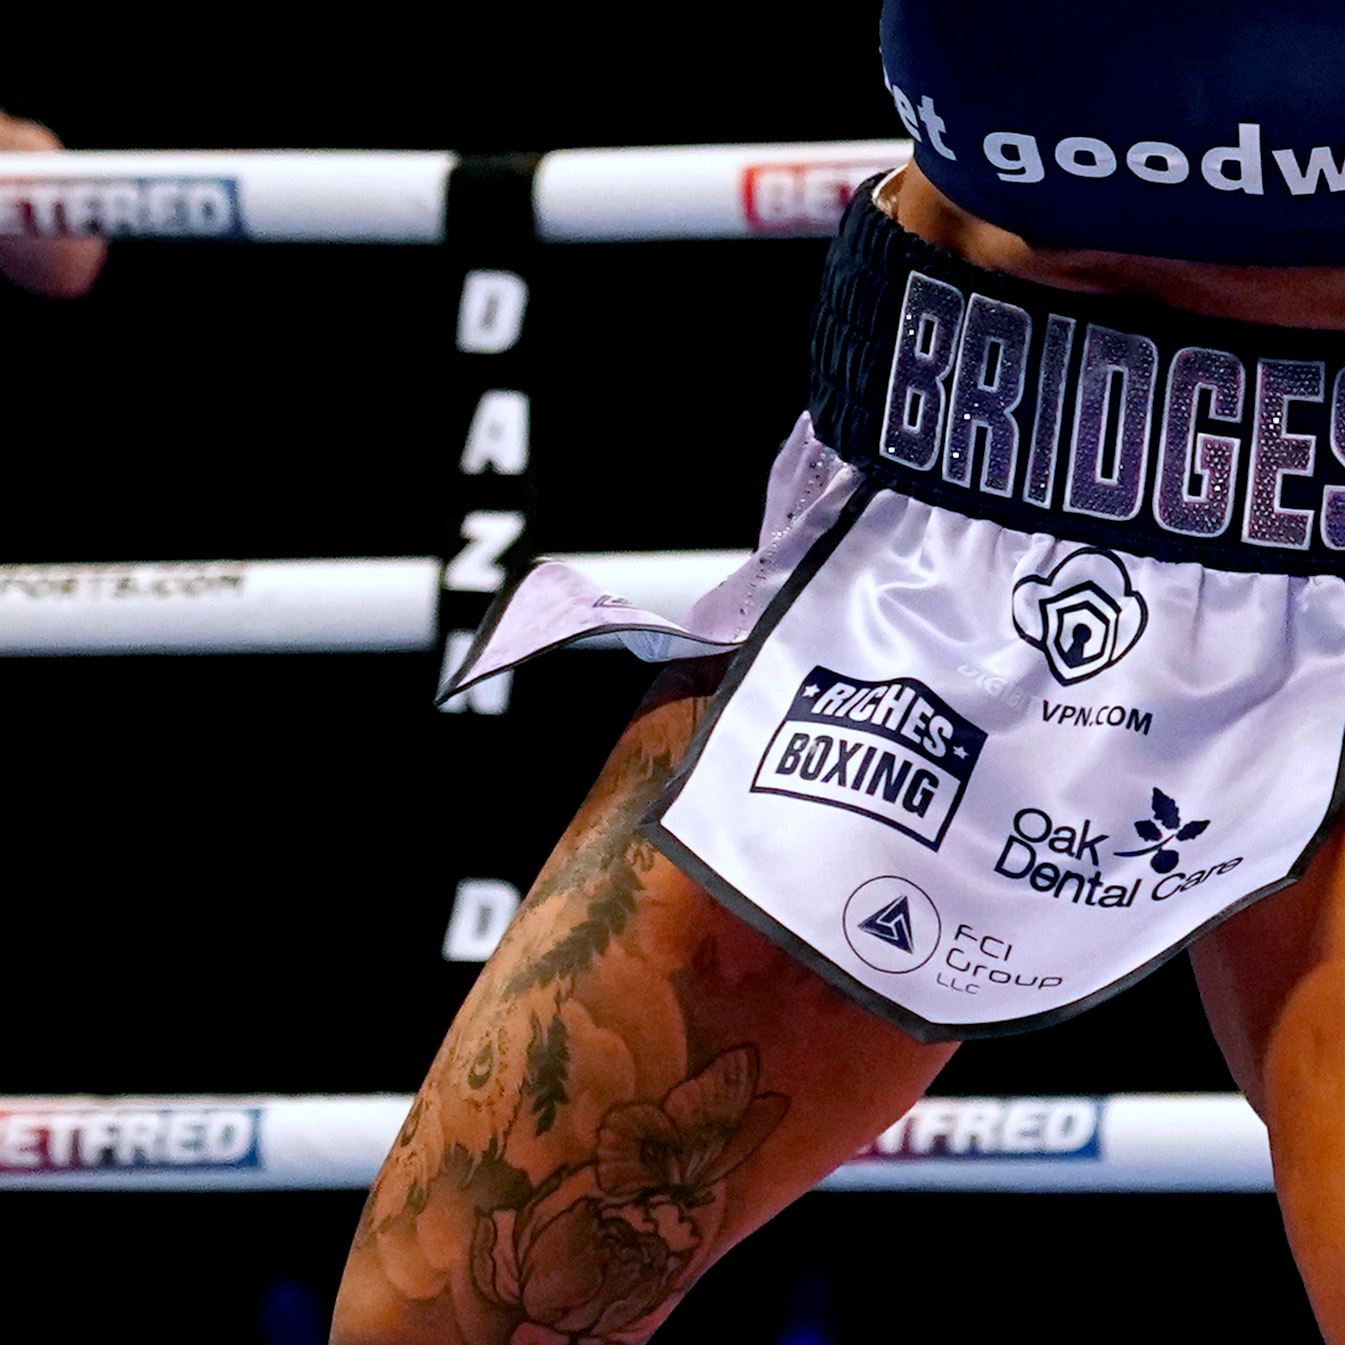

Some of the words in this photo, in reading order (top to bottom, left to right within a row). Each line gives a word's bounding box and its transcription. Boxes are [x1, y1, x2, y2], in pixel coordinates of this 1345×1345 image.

[884, 67, 957, 161] et
[0, 181, 232, 236] ETFRED
[810, 682, 954, 758] RICHES
[1042, 699, 1153, 736] VPN.COM
[774, 732, 940, 819] BOXING
[1013, 807, 1110, 867] Oak
[993, 834, 1142, 908] Dental
[1150, 856, 1244, 901] Care
[945, 947, 1063, 989] Group
[953, 923, 1013, 962] FCI
[936, 971, 980, 995] LLC
[0, 1112, 252, 1167] ETFRED
[874, 1104, 1099, 1155] TFRED
